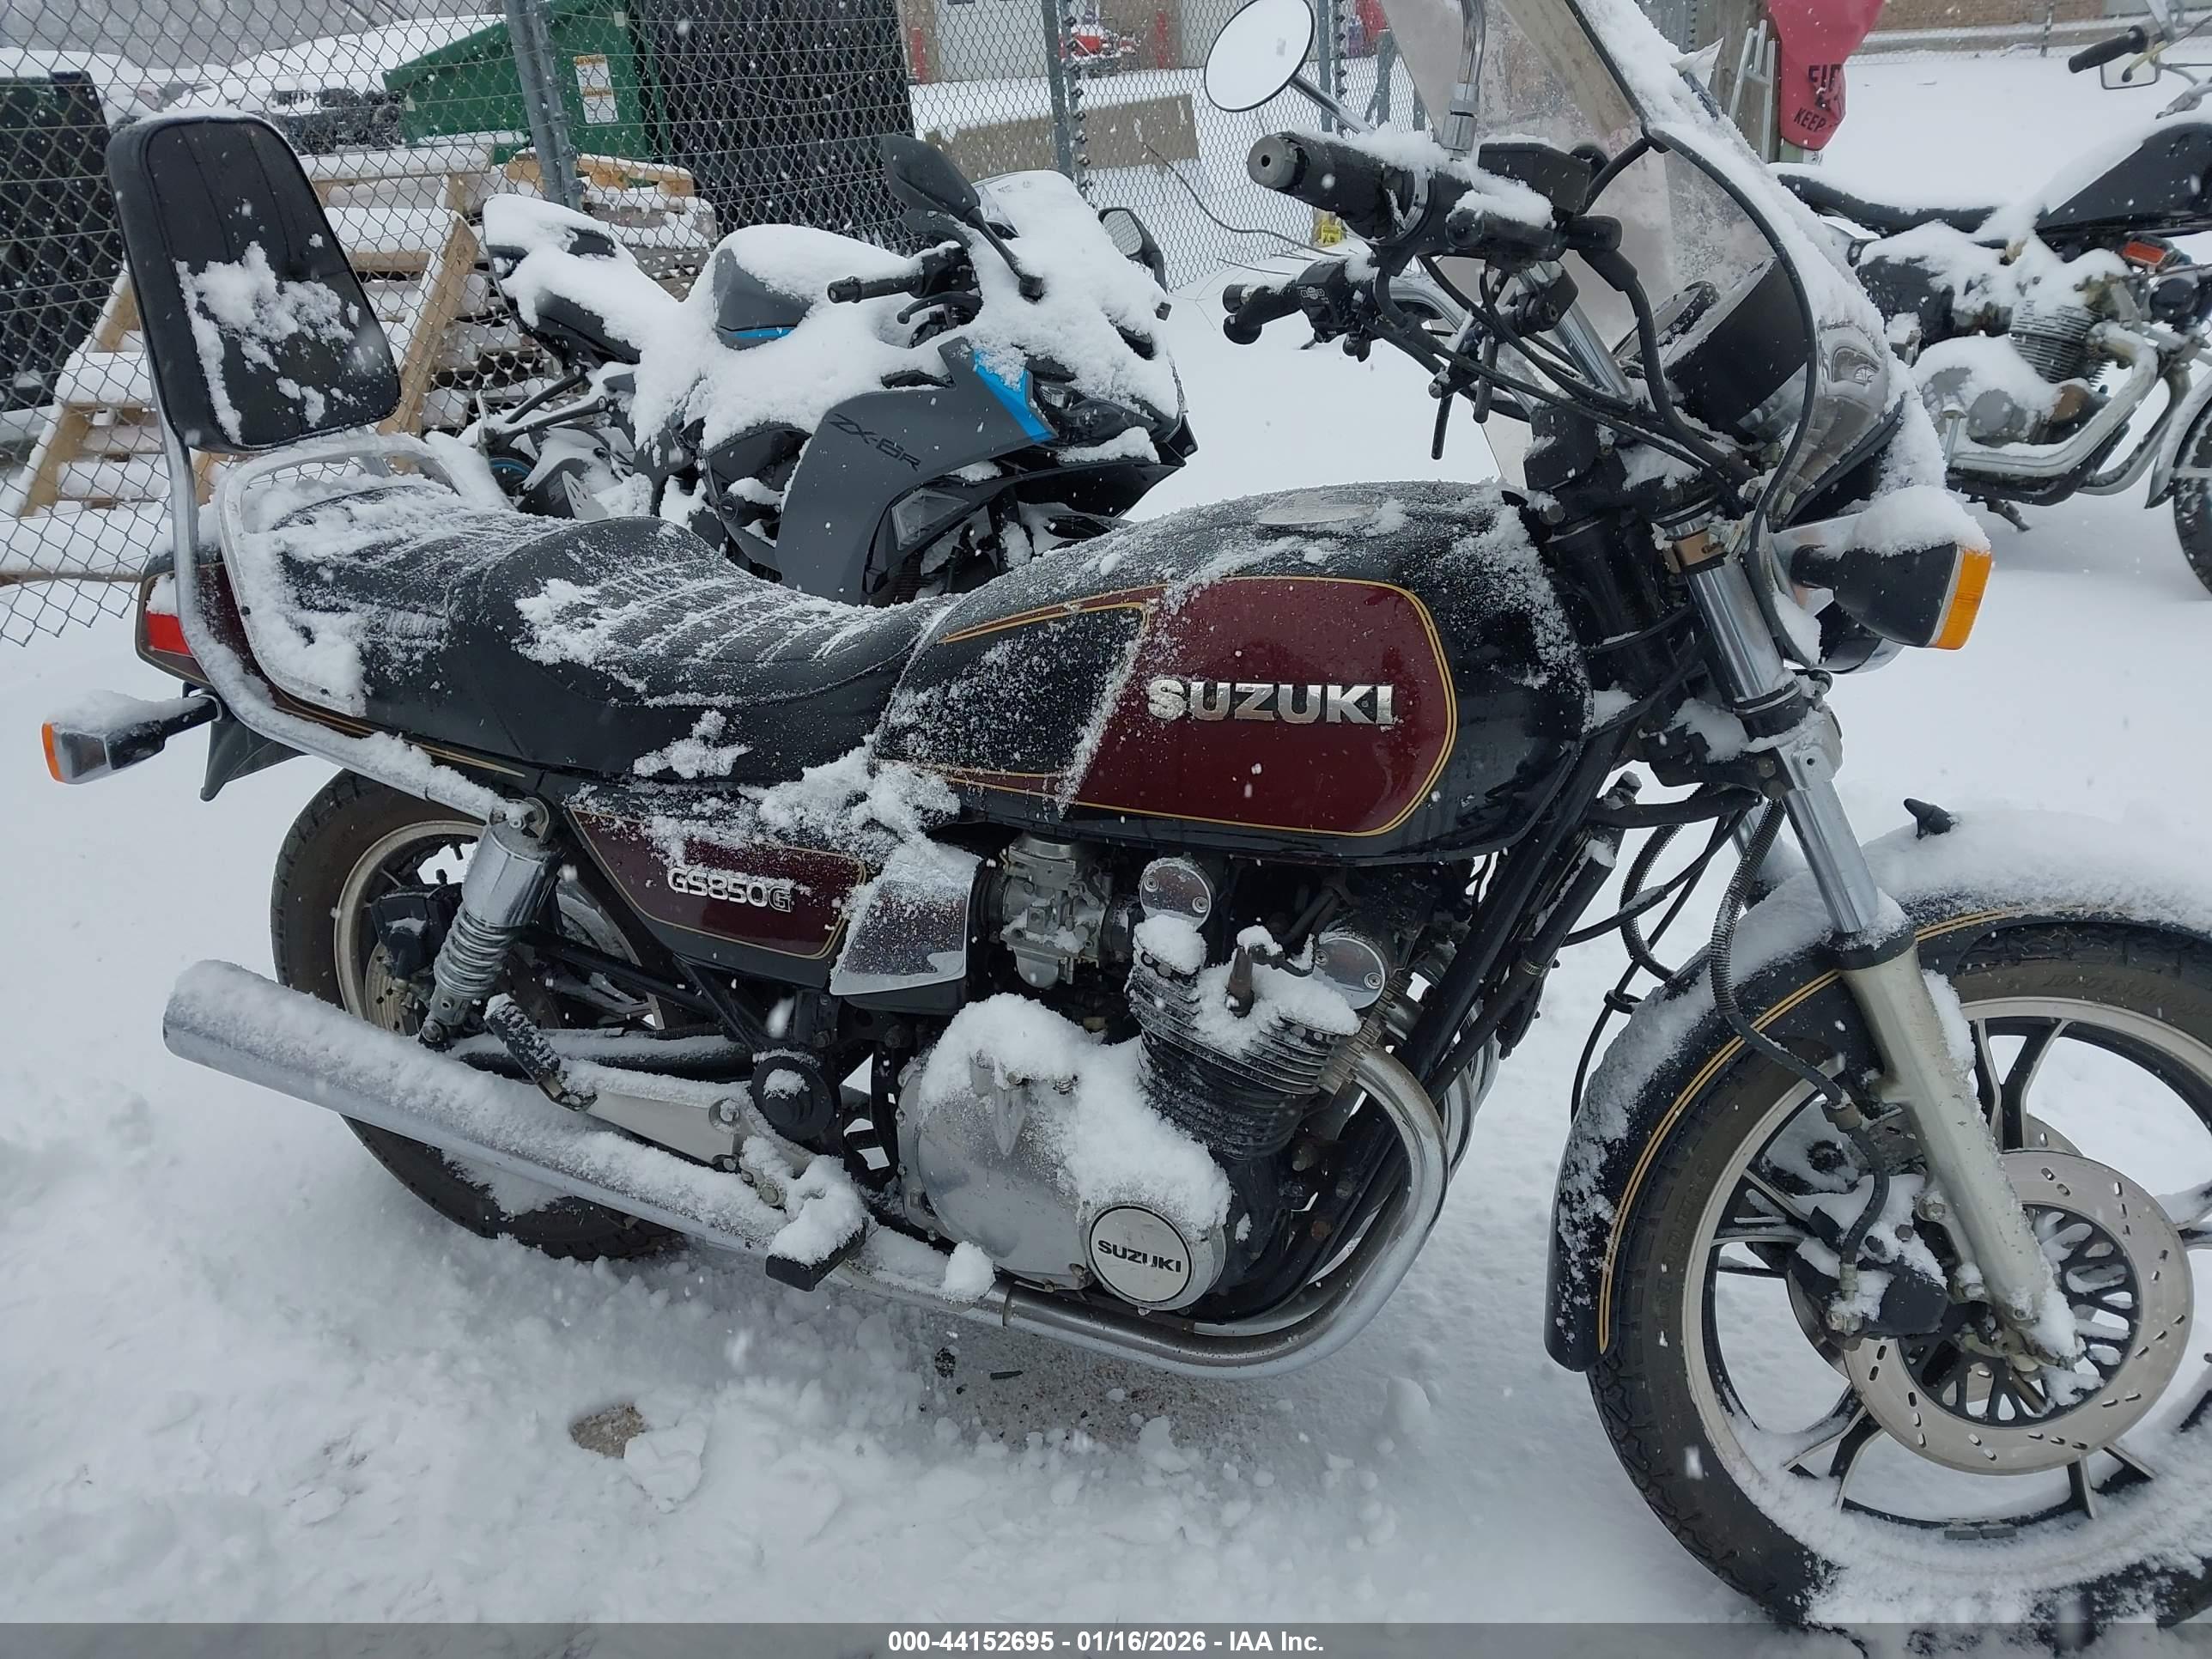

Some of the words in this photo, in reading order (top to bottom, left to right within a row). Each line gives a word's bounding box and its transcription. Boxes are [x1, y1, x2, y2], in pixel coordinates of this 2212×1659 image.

[1793, 107, 1826, 132] KEEP
[829, 412, 921, 472] ZX-6R
[1147, 678, 1395, 725] SUZUKI
[667, 867, 792, 913] GS850G
[1097, 1239, 1182, 1273] SUZUKI
